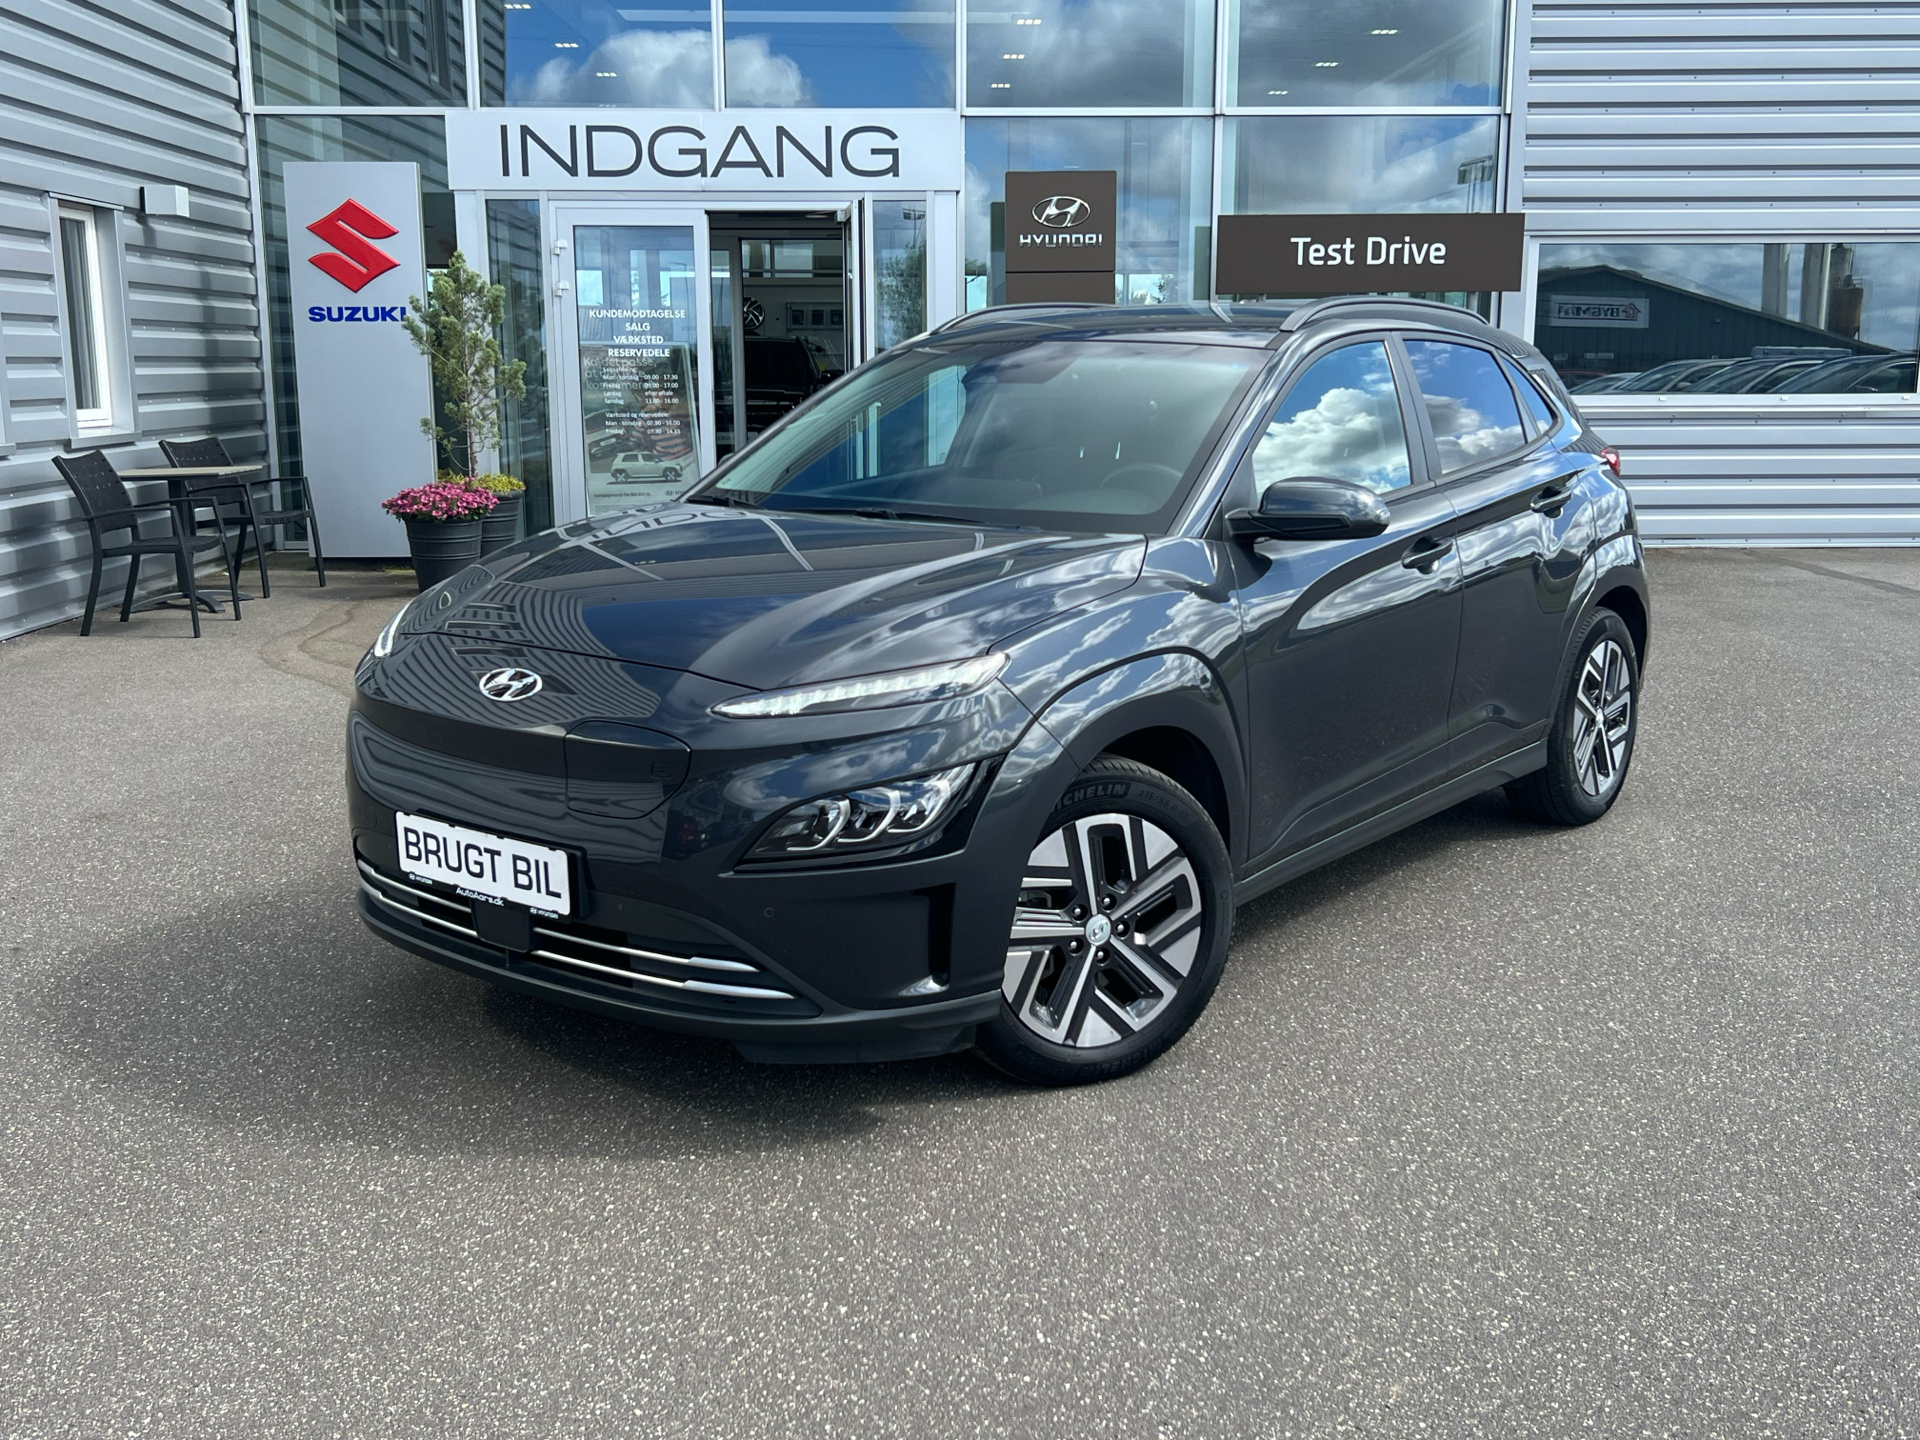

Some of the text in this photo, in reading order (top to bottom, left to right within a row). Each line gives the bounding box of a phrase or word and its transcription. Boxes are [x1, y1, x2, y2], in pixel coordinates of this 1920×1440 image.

[500, 124, 900, 178] INDGANG
[1018, 233, 1103, 248] HYUNDAI
[1290, 235, 1447, 266] Test Drive
[308, 305, 407, 322] SUZUKI
[589, 309, 686, 319] KUNDEMODTAGELSE
[625, 322, 651, 332] SALG
[613, 335, 664, 344] VÆRKSTED
[607, 348, 671, 357] RESERVEDELE
[1054, 784, 1127, 811] ICHELIN
[403, 826, 563, 900] BRUGT BIL
